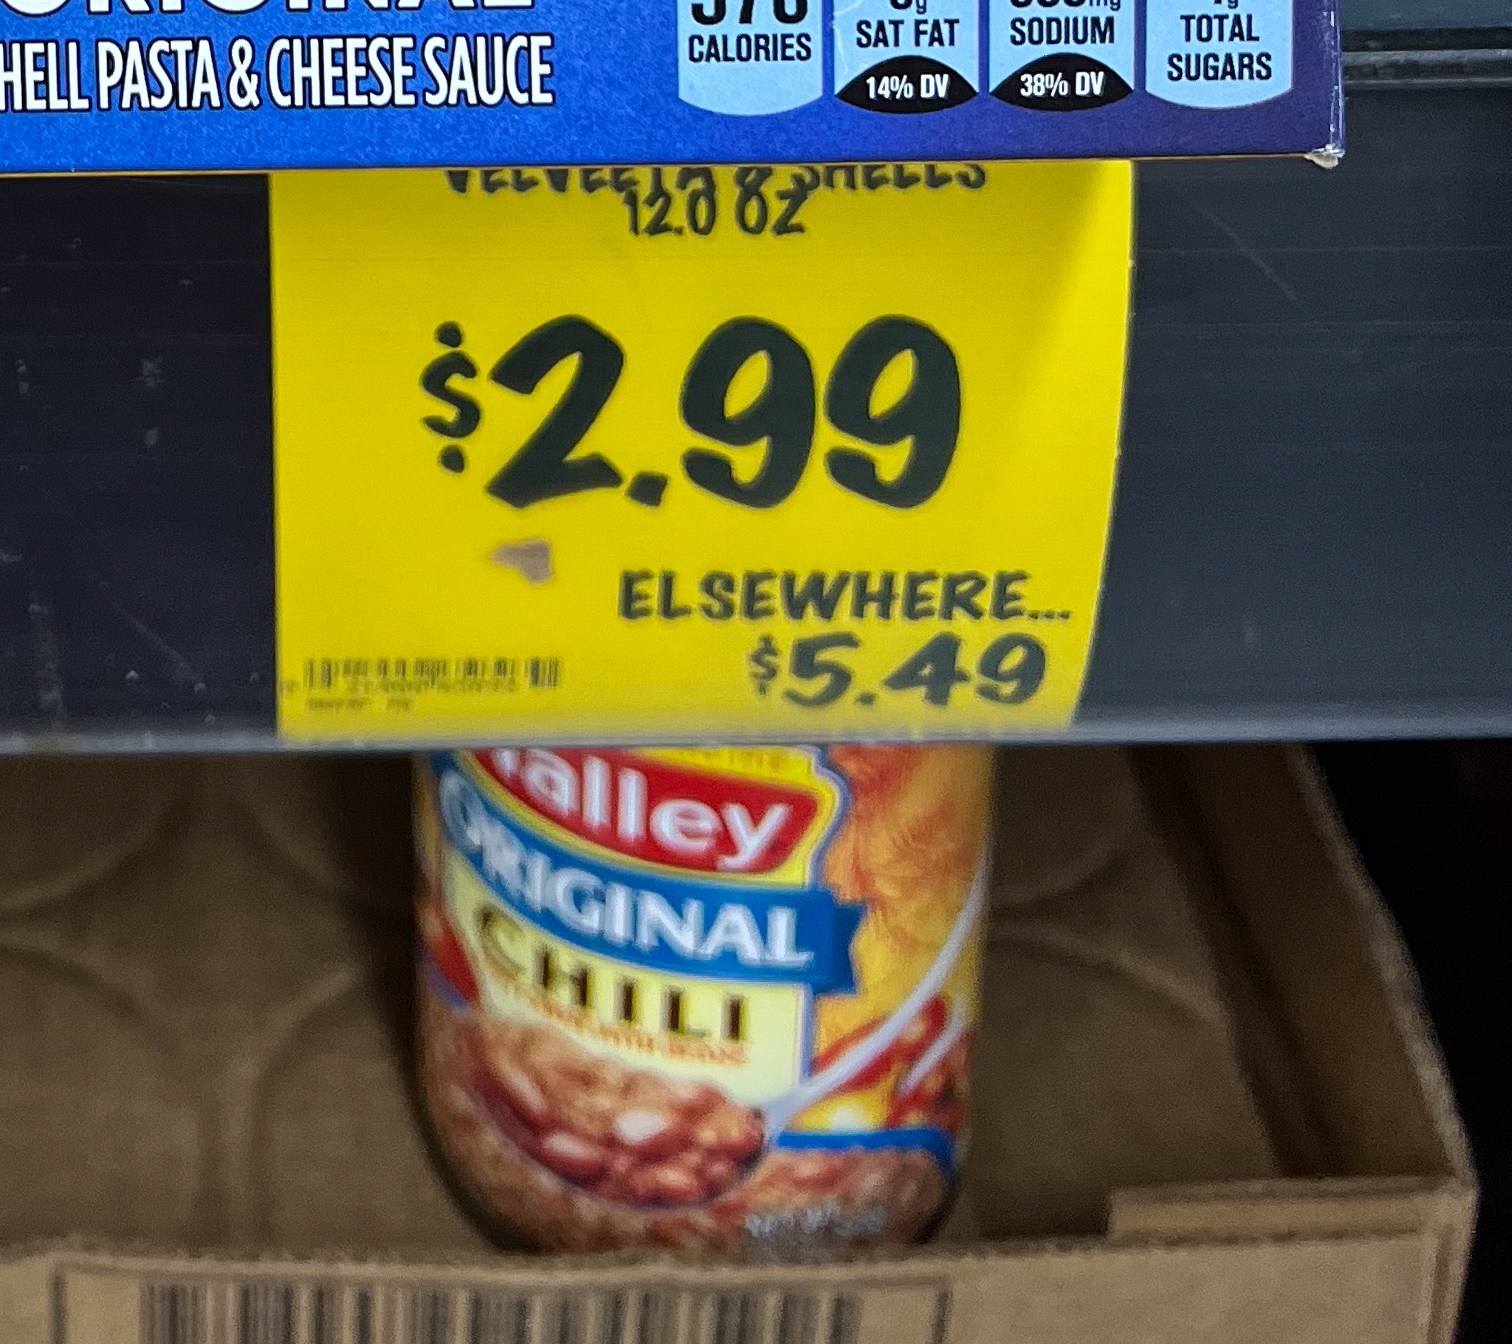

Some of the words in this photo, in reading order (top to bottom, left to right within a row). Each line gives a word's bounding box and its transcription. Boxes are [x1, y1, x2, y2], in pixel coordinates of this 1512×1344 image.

[856, 20, 904, 48] SAT
[914, 19, 960, 47] FAT
[1010, 16, 1115, 45] SODIUM
[1180, 15, 1259, 44] TOTAL
[688, 33, 813, 64] CALORIES
[97, 38, 221, 109] PASTA
[229, 37, 260, 107] &
[268, 35, 416, 106] CHEESE
[423, 34, 555, 105] SAUCE
[1167, 53, 1273, 82] SUGARS
[866, 74, 914, 99] 14%
[919, 73, 949, 98] DV
[1020, 73, 1069, 98] 38%
[1074, 72, 1104, 96] DV
[419, 313, 963, 509] $2.99
[617, 569, 1073, 622] ELSEWHERE...
[747, 631, 1049, 708] $5.49
[439, 769, 813, 969] ORIGINAL
[477, 906, 749, 1046] CHILI
